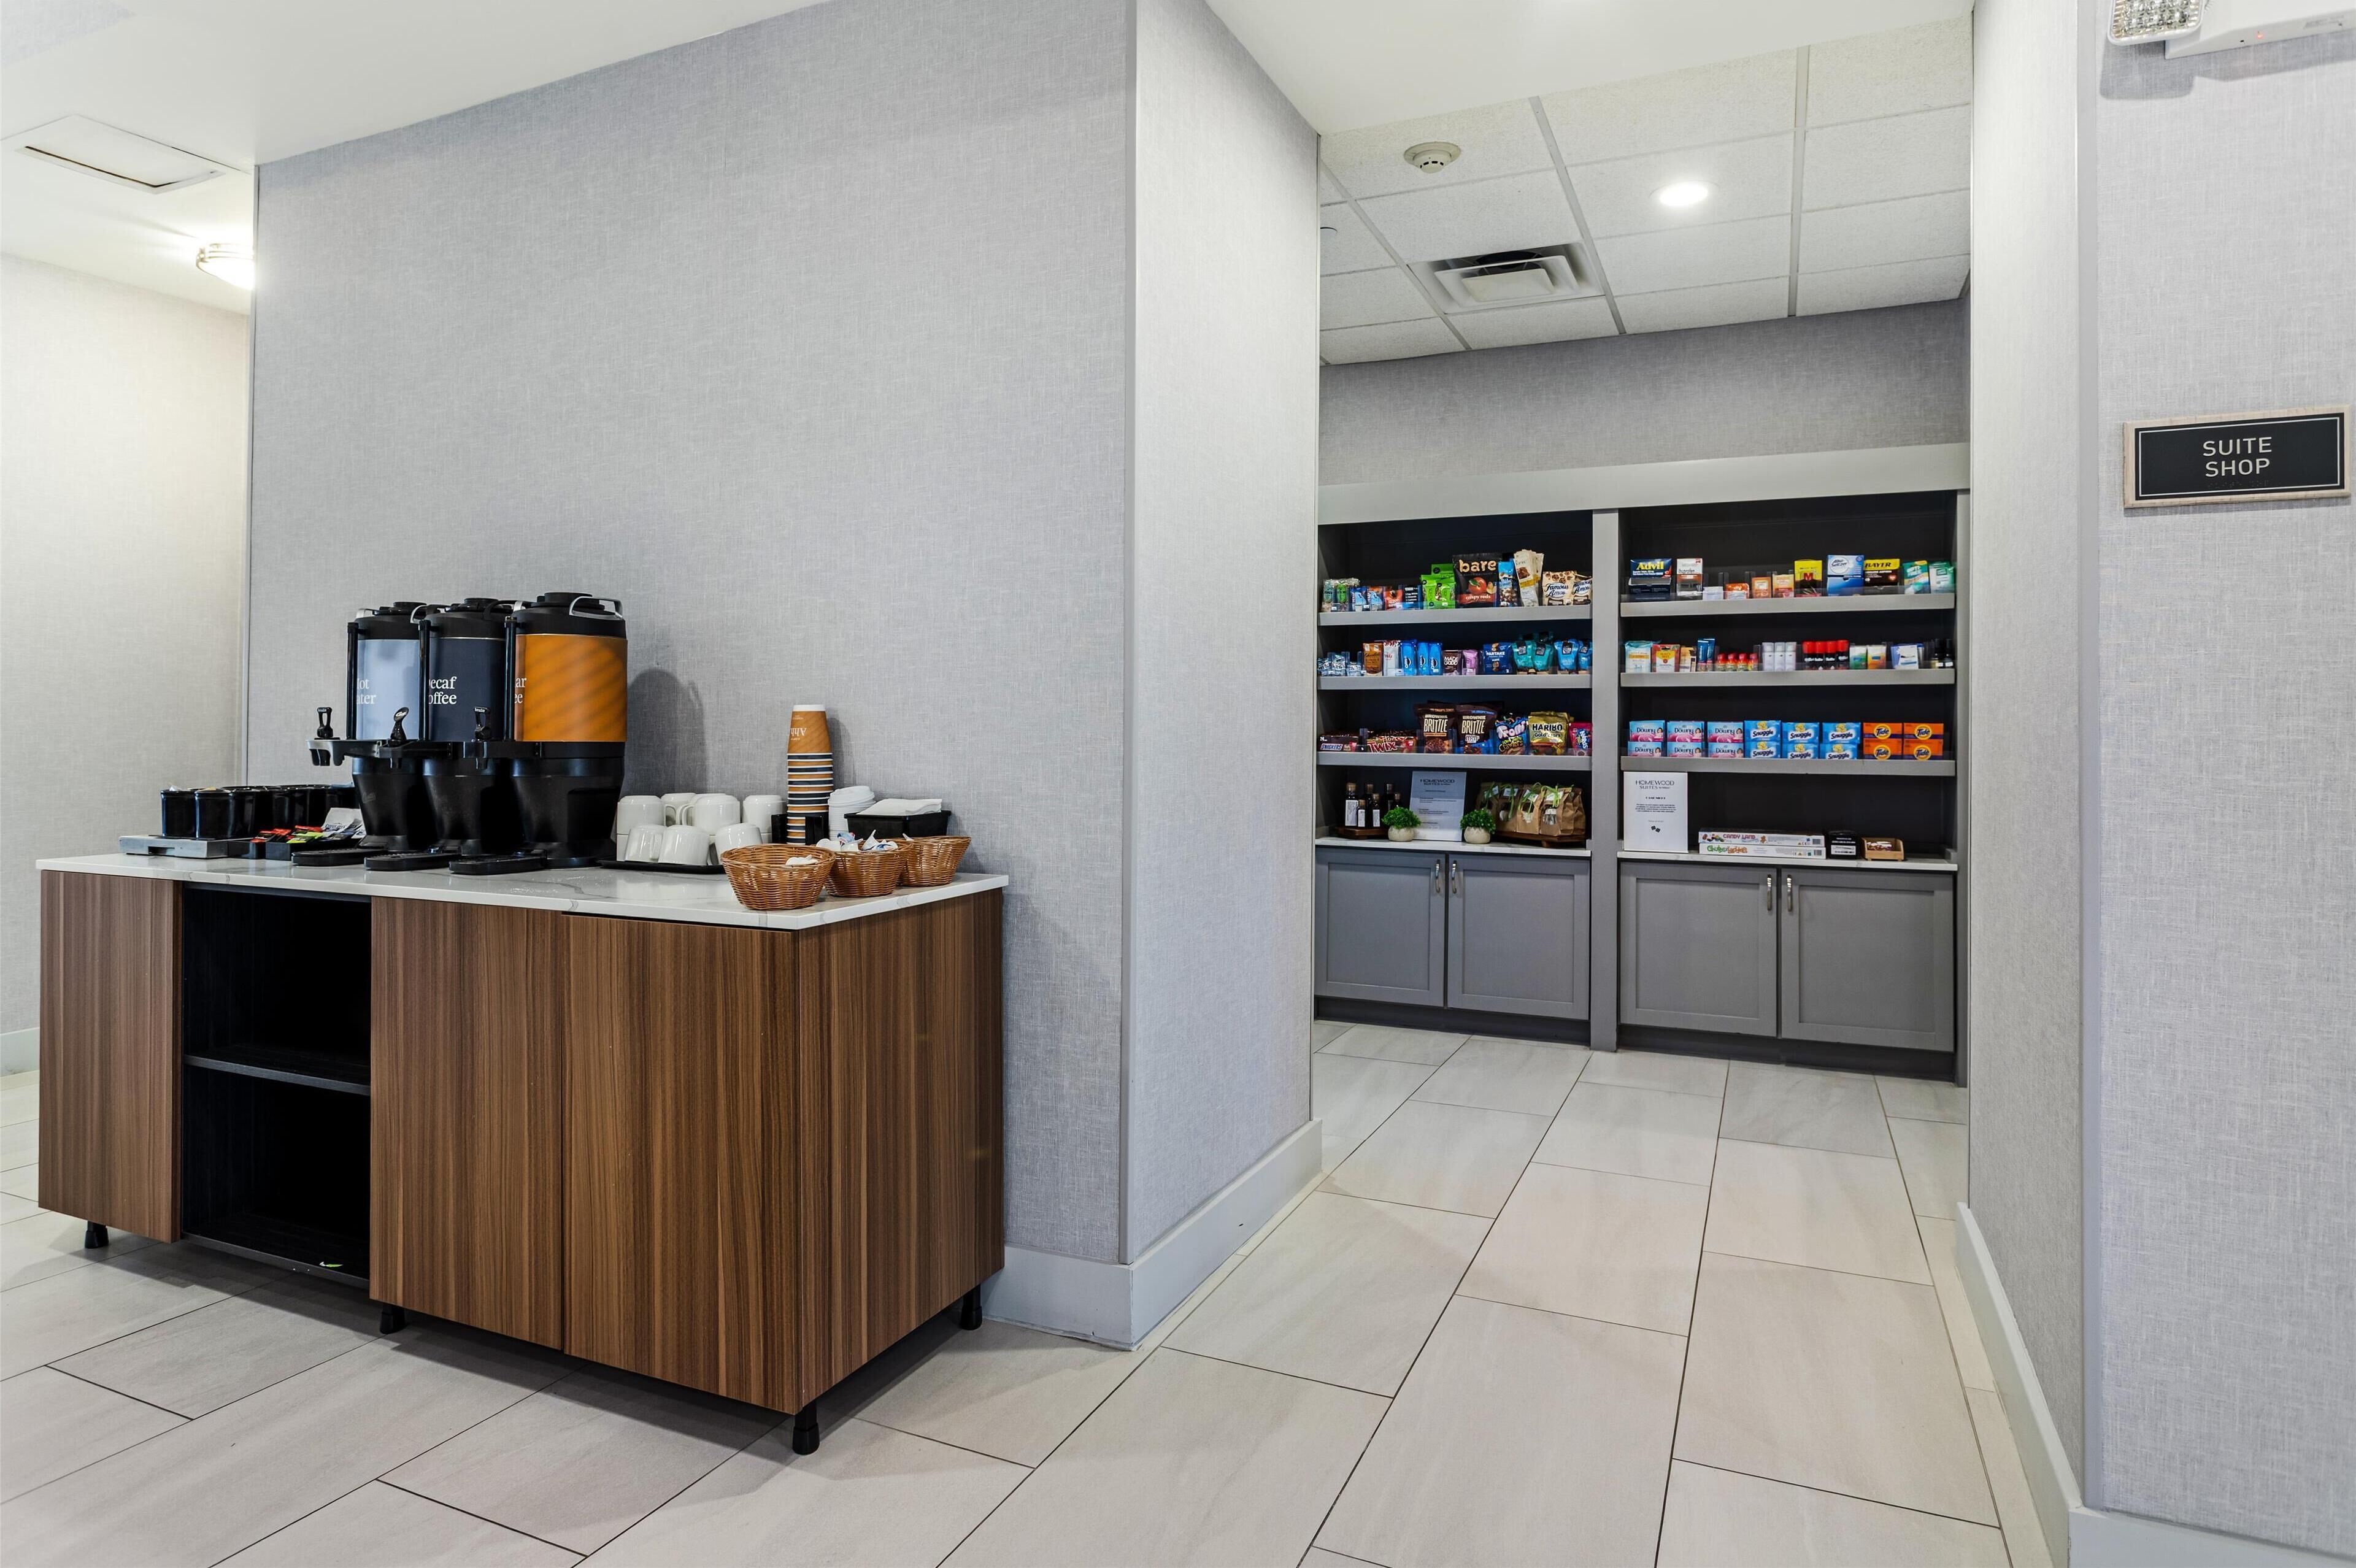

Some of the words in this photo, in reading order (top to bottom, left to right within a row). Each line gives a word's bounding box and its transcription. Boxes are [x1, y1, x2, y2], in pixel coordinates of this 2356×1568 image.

[2203, 436, 2272, 456] SUITE
[2205, 458, 2270, 477] SHOP
[1458, 559, 1496, 573] bare
[1636, 561, 1664, 570] Advil
[1544, 583, 1569, 592] Famous
[429, 676, 457, 689] ecaf
[428, 691, 457, 704] offee
[1423, 718, 1449, 733] BRITTLE
[1461, 720, 1485, 734] BRITTLE
[1367, 741, 1398, 753] TWIX
